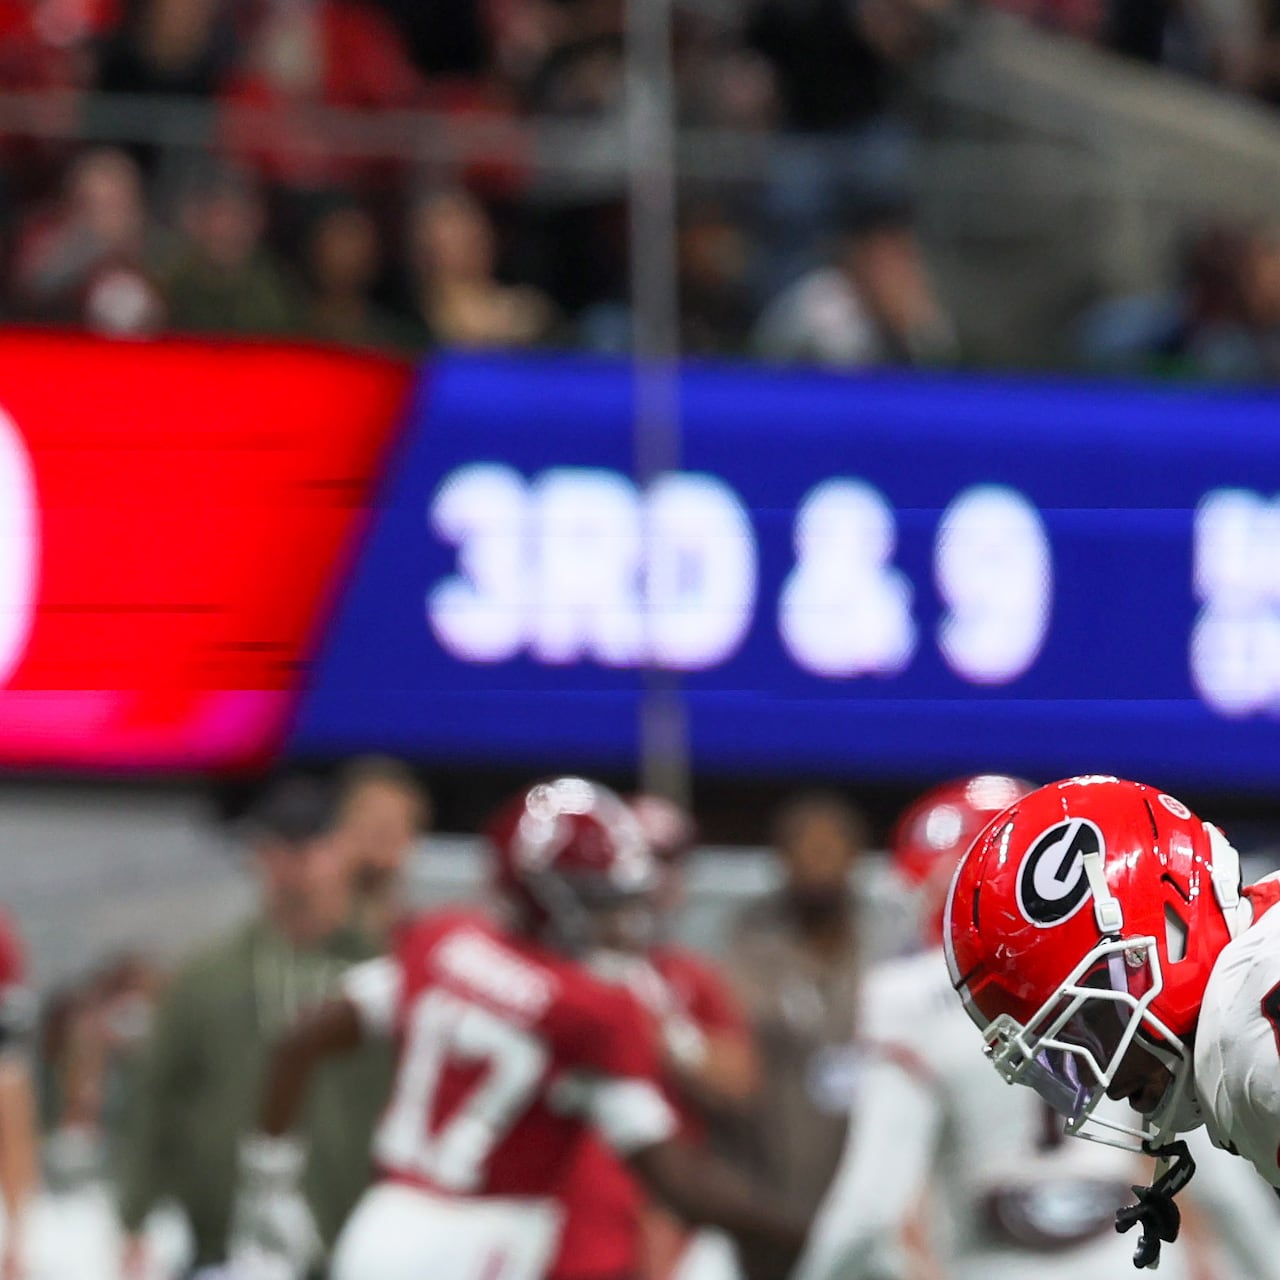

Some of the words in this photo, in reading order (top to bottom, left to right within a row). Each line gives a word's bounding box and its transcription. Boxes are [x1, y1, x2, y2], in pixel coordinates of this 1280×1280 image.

[426, 461, 758, 672] 3RD
[777, 476, 917, 679] &
[932, 482, 1052, 685] 9
[373, 985, 548, 1194] 17
